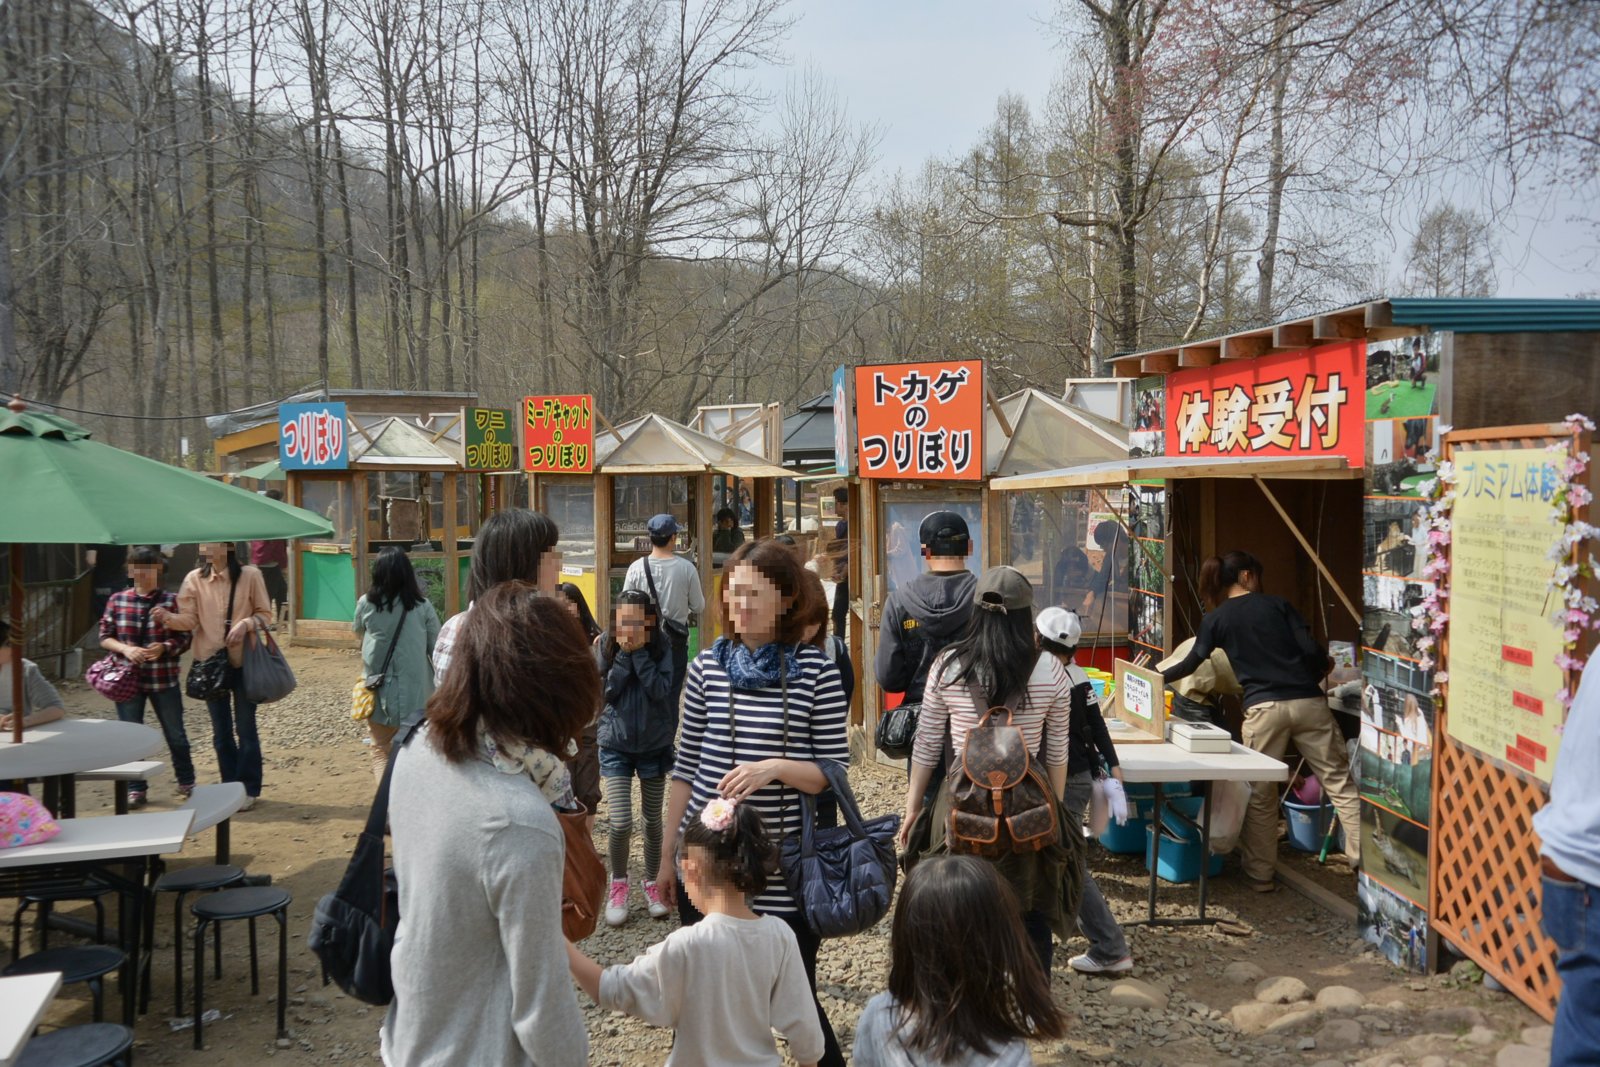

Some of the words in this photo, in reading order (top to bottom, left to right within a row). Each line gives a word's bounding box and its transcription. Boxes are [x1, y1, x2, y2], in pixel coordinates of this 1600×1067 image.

[874, 366, 971, 405] トカゲ
[475, 409, 505, 430] ワニ
[527, 398, 590, 429] ミーアキャット
[904, 404, 928, 430] の
[1176, 372, 1347, 453] 体験受付
[283, 408, 343, 465] つりぼり
[484, 427, 496, 443] の
[553, 429, 563, 444] の
[466, 441, 512, 468] つりぼり
[529, 442, 588, 469] つりぼり
[861, 426, 971, 474] つりぼり
